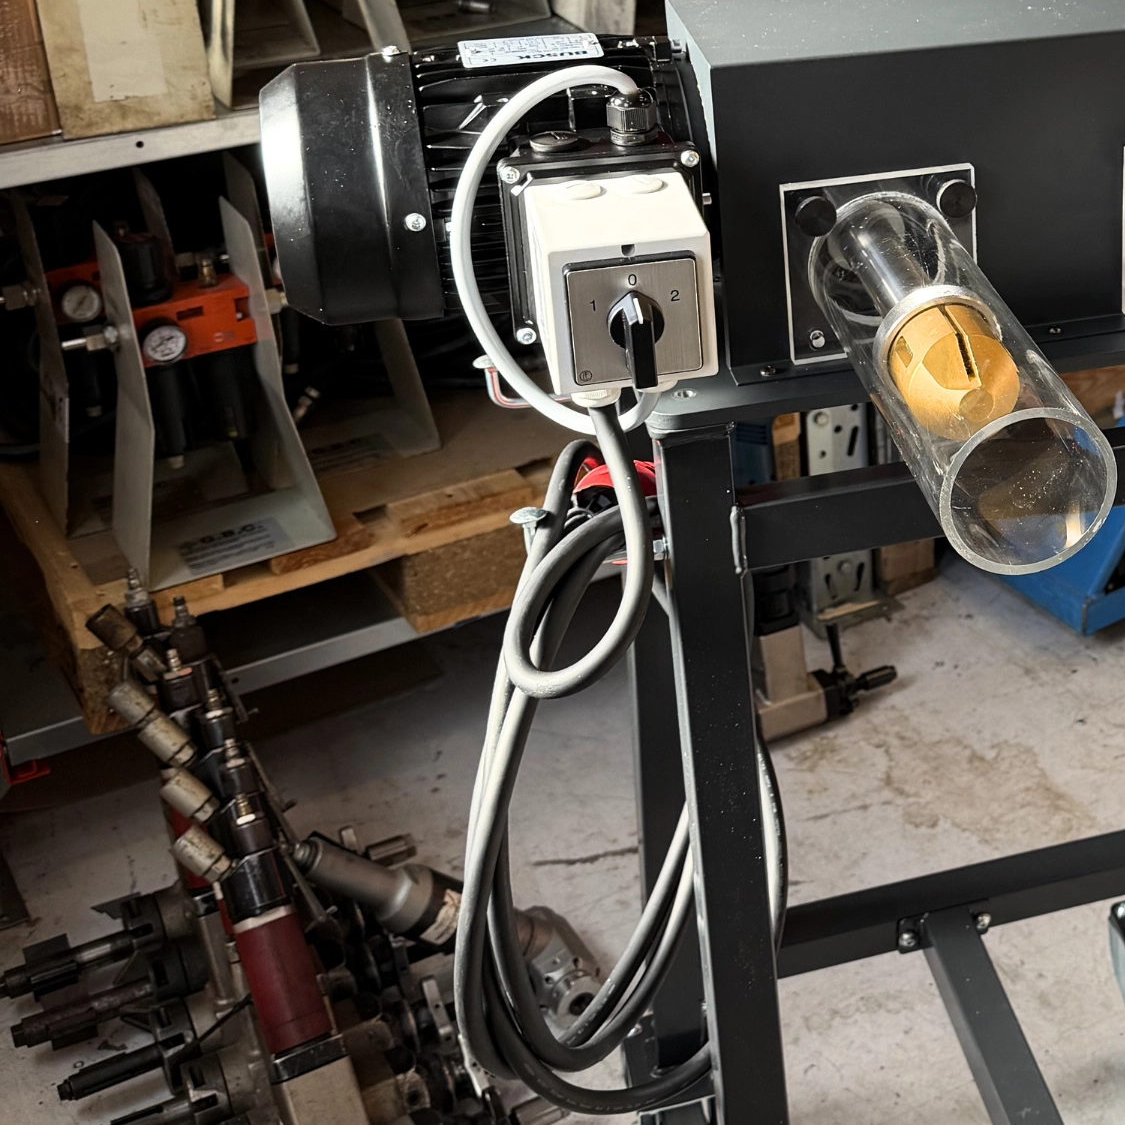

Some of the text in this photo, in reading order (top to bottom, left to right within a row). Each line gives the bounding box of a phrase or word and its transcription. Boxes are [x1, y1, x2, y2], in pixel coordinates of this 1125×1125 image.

[628, 274, 637, 286] 0
[670, 289, 681, 302] 2
[589, 299, 597, 312] 1
